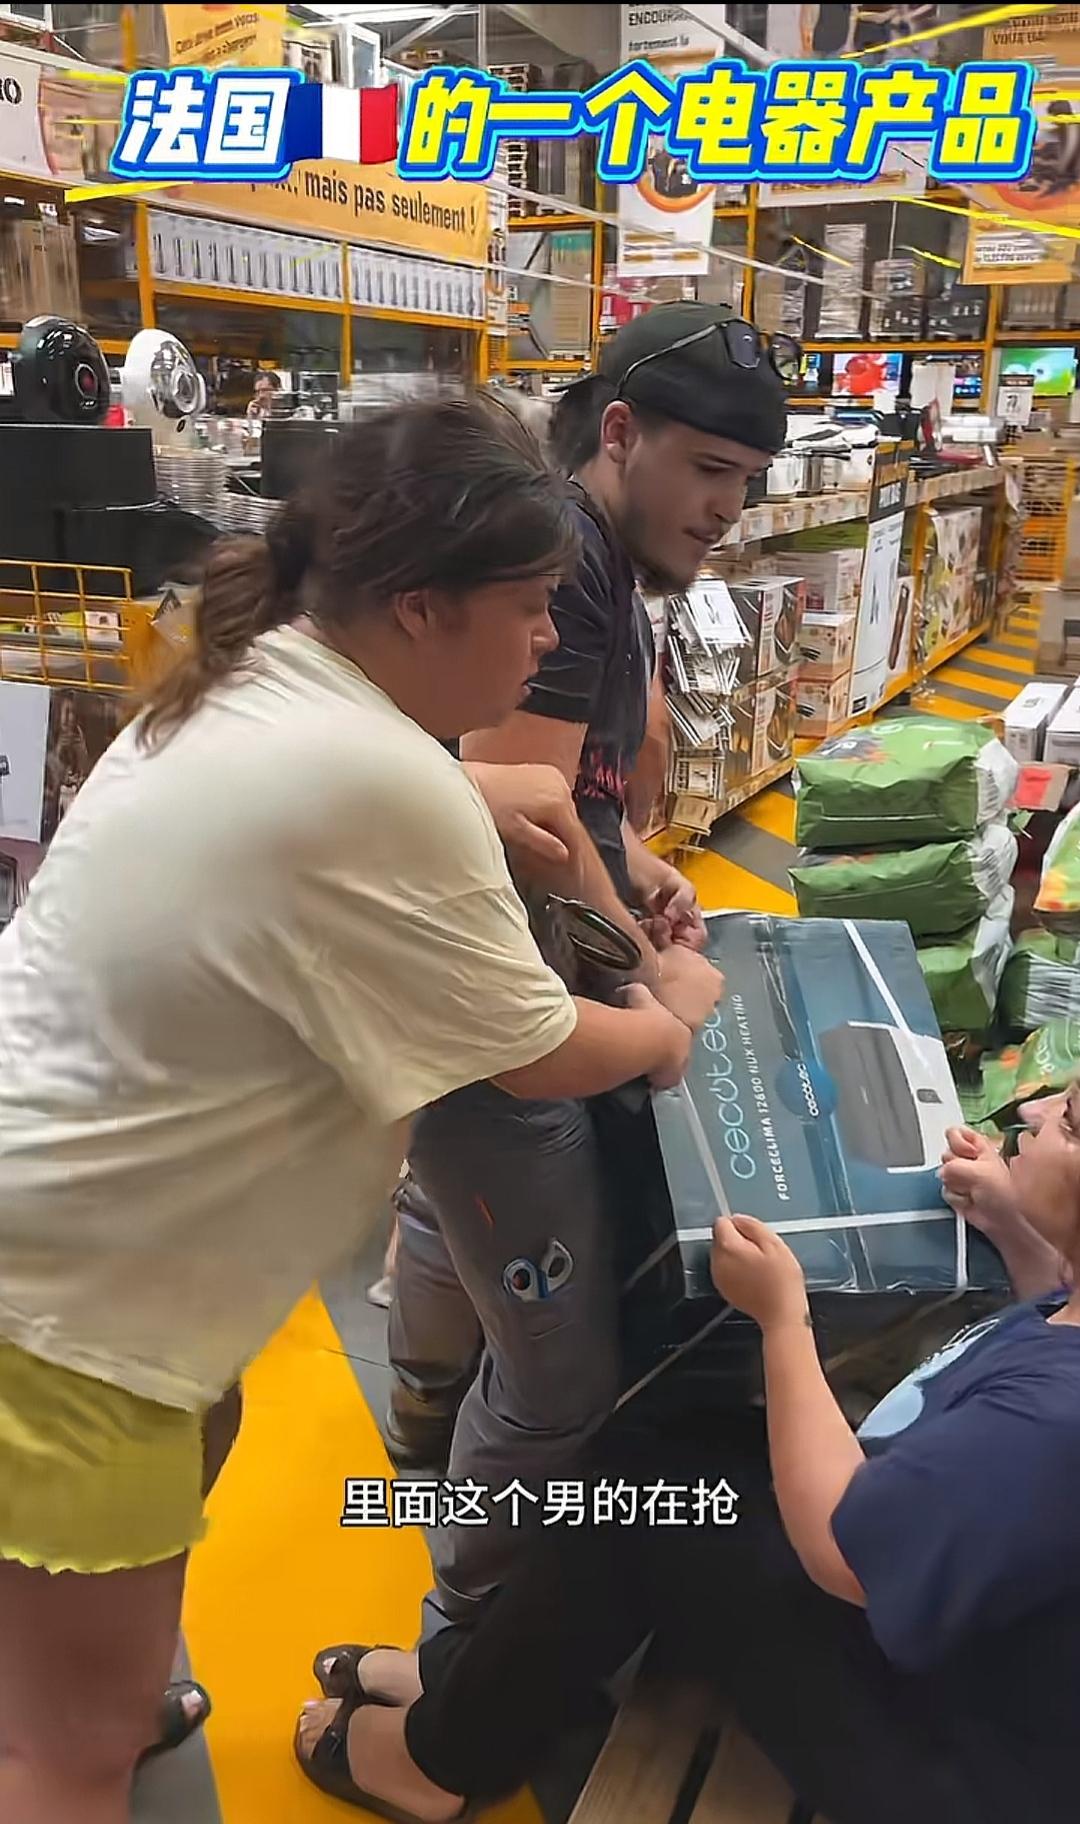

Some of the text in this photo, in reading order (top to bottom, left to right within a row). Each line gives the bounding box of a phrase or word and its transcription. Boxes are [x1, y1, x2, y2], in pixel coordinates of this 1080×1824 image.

[304, 169, 348, 206] mais
[353, 183, 386, 217] pas
[391, 190, 466, 231] seulement
[731, 993, 752, 1045] HEATING
[751, 1077, 769, 1113] 12600
[796, 1062, 819, 1117] cecotec
[760, 1117, 790, 1201] FORCECLIMA
